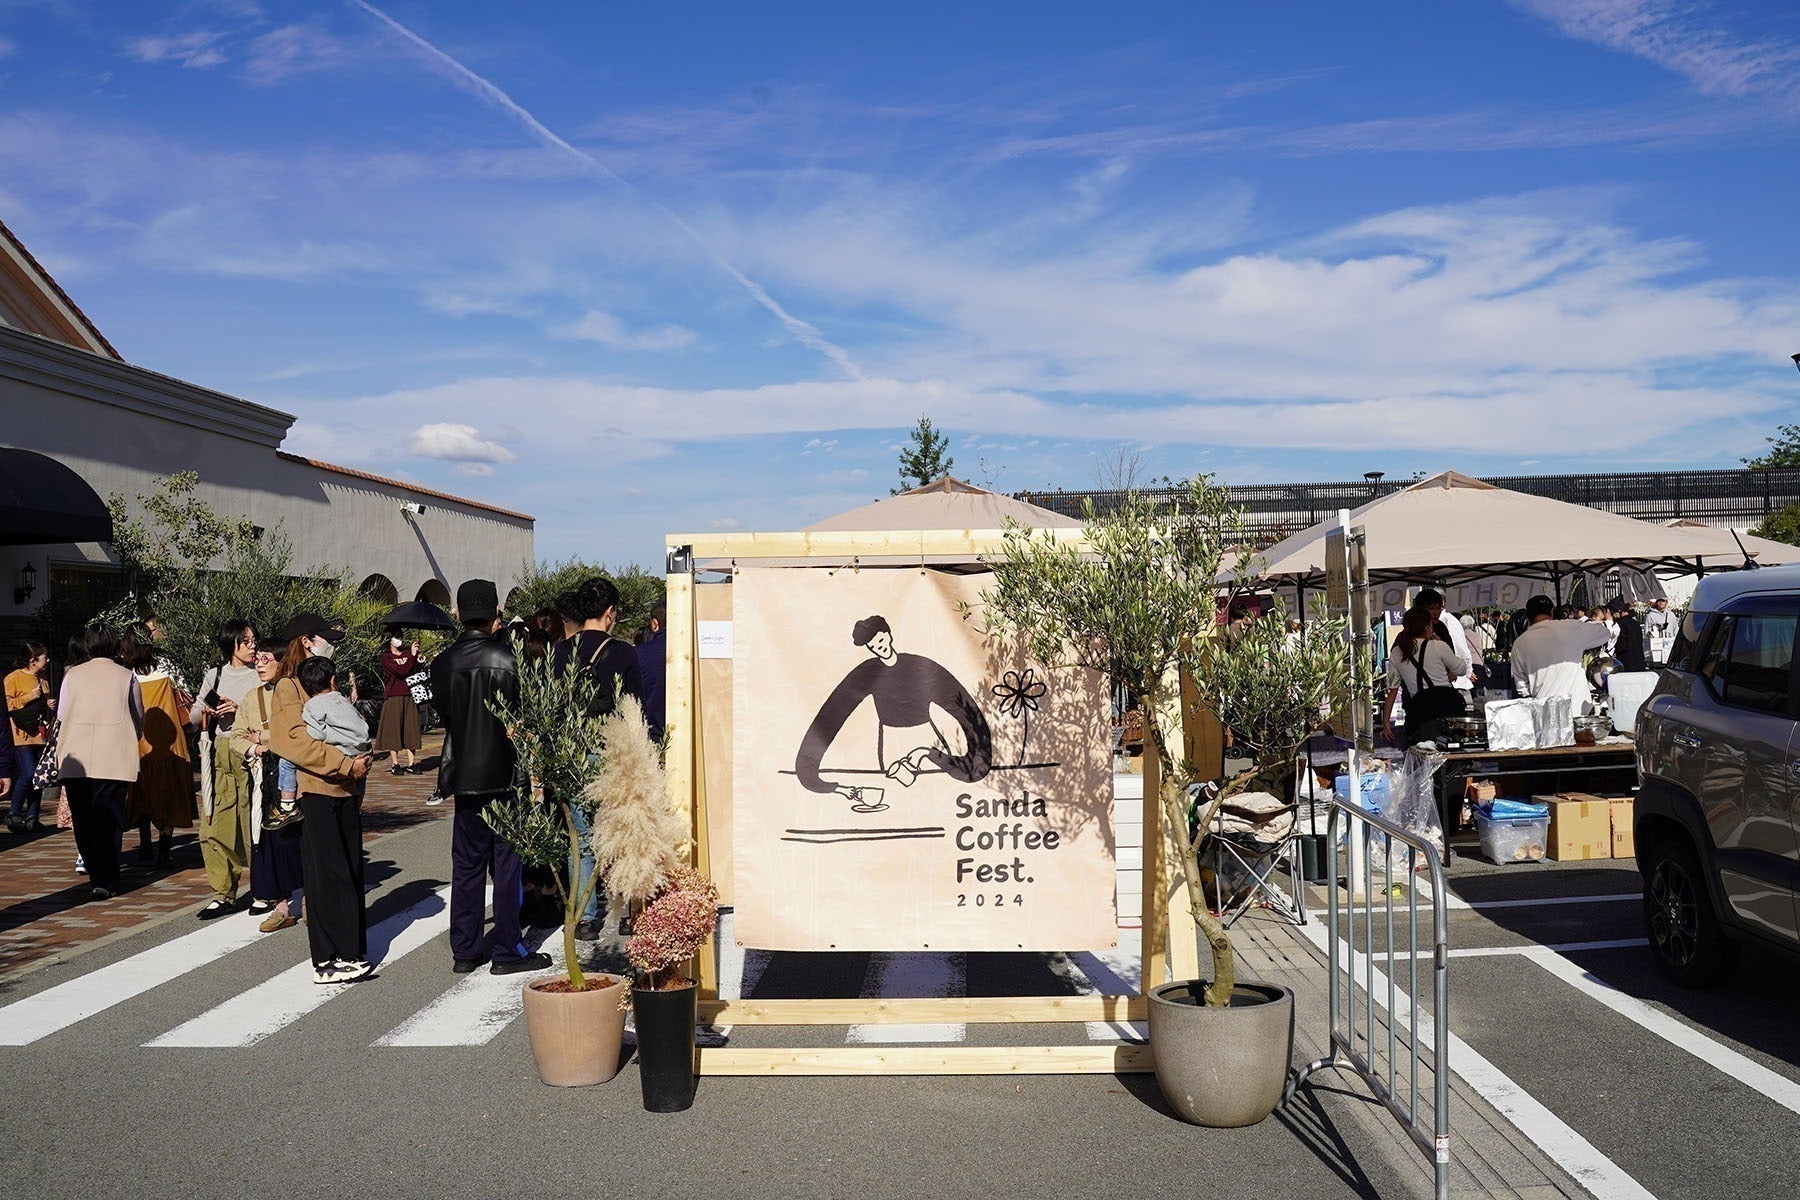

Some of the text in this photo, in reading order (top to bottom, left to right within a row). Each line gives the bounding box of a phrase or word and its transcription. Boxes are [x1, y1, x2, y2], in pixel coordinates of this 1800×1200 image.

[955, 790, 1048, 819] Sanda
[955, 823, 1060, 851] Coffee
[956, 857, 1035, 883] Fest.
[957, 894, 1023, 907] 2024
